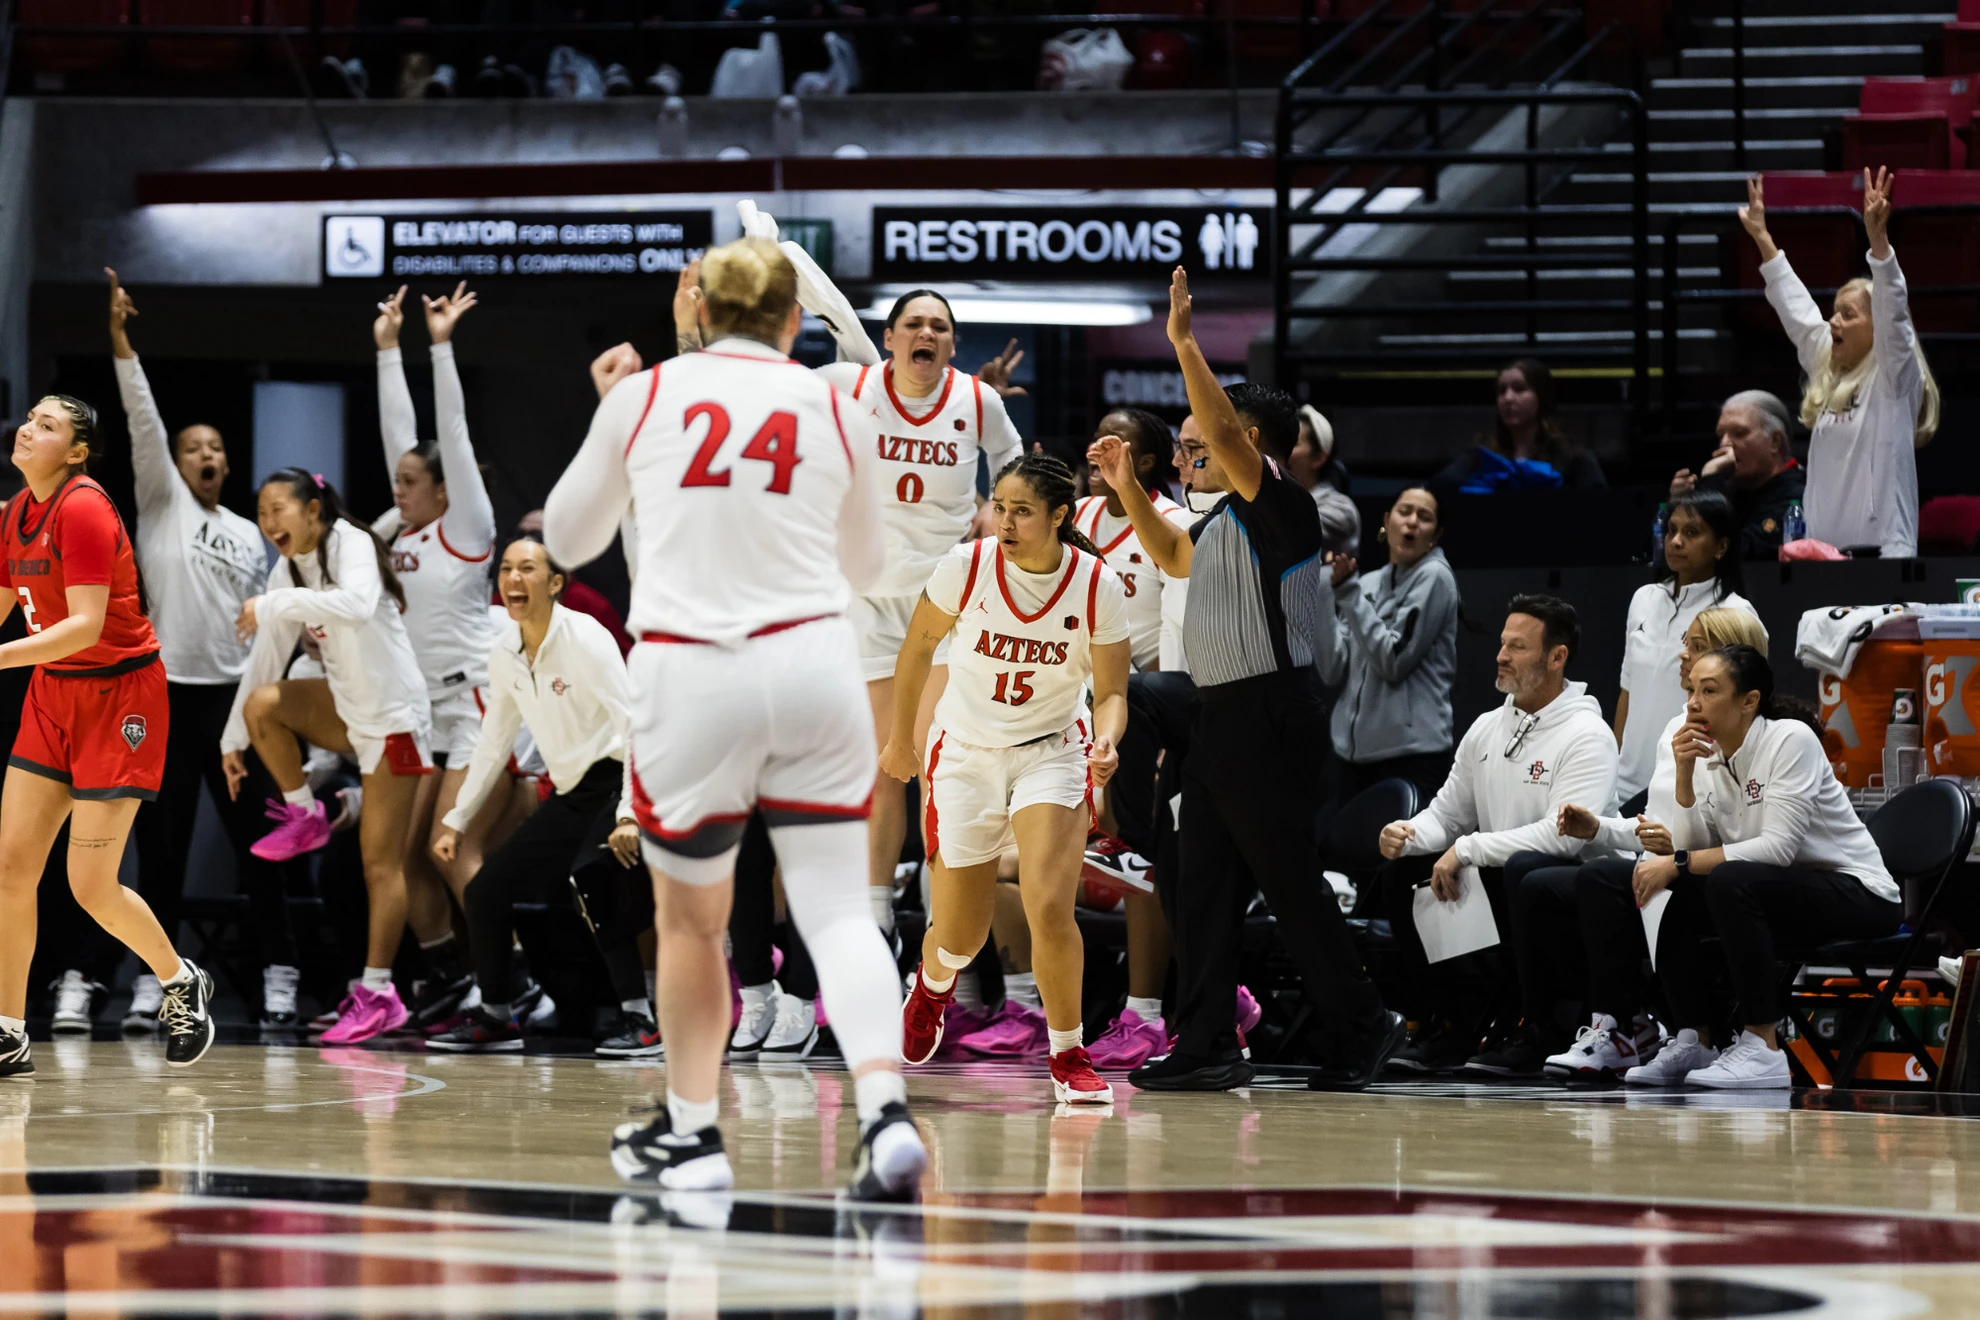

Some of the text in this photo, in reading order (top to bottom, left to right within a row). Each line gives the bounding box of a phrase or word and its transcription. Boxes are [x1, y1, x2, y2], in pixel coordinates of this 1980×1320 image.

[394, 221, 684, 246] ELEVATOR FOR GUESTS WITH
[885, 220, 1183, 263] RESTROOMS
[393, 254, 499, 275] DISABILITIES
[501, 254, 515, 275] &
[517, 253, 638, 274] COMPANIONS
[680, 401, 802, 495] 24
[896, 472, 924, 504] 0
[17, 586, 42, 633] 2
[974, 629, 1069, 666] AZTECS
[991, 671, 1036, 706] 15
[1926, 663, 1945, 706] G
